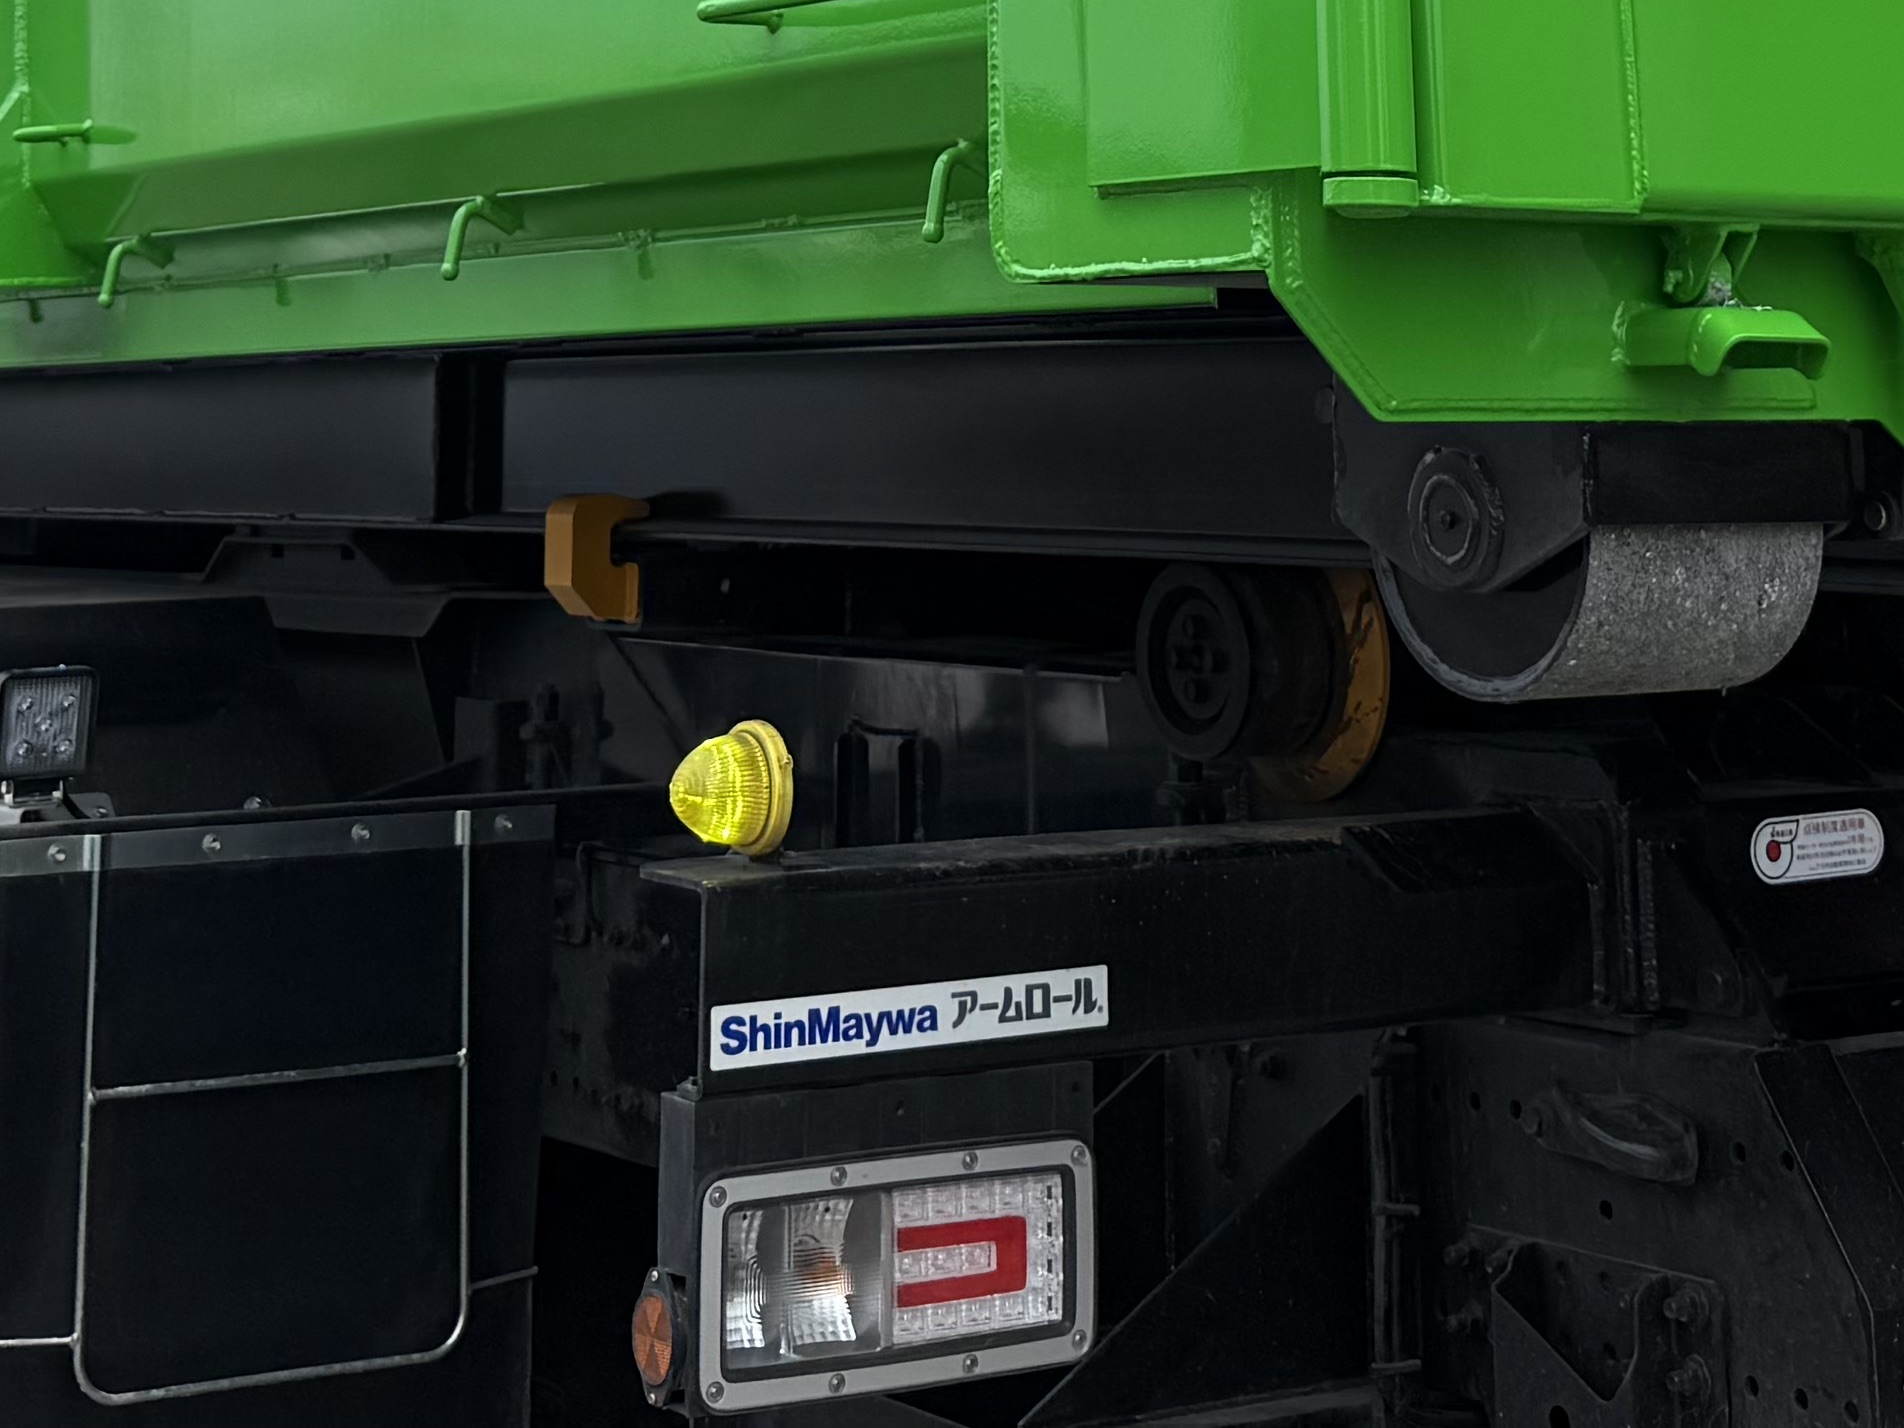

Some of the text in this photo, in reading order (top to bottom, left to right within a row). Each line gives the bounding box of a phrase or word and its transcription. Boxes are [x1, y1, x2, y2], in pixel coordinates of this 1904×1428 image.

[720, 977, 1098, 1056] ShinMaywa アームロール
